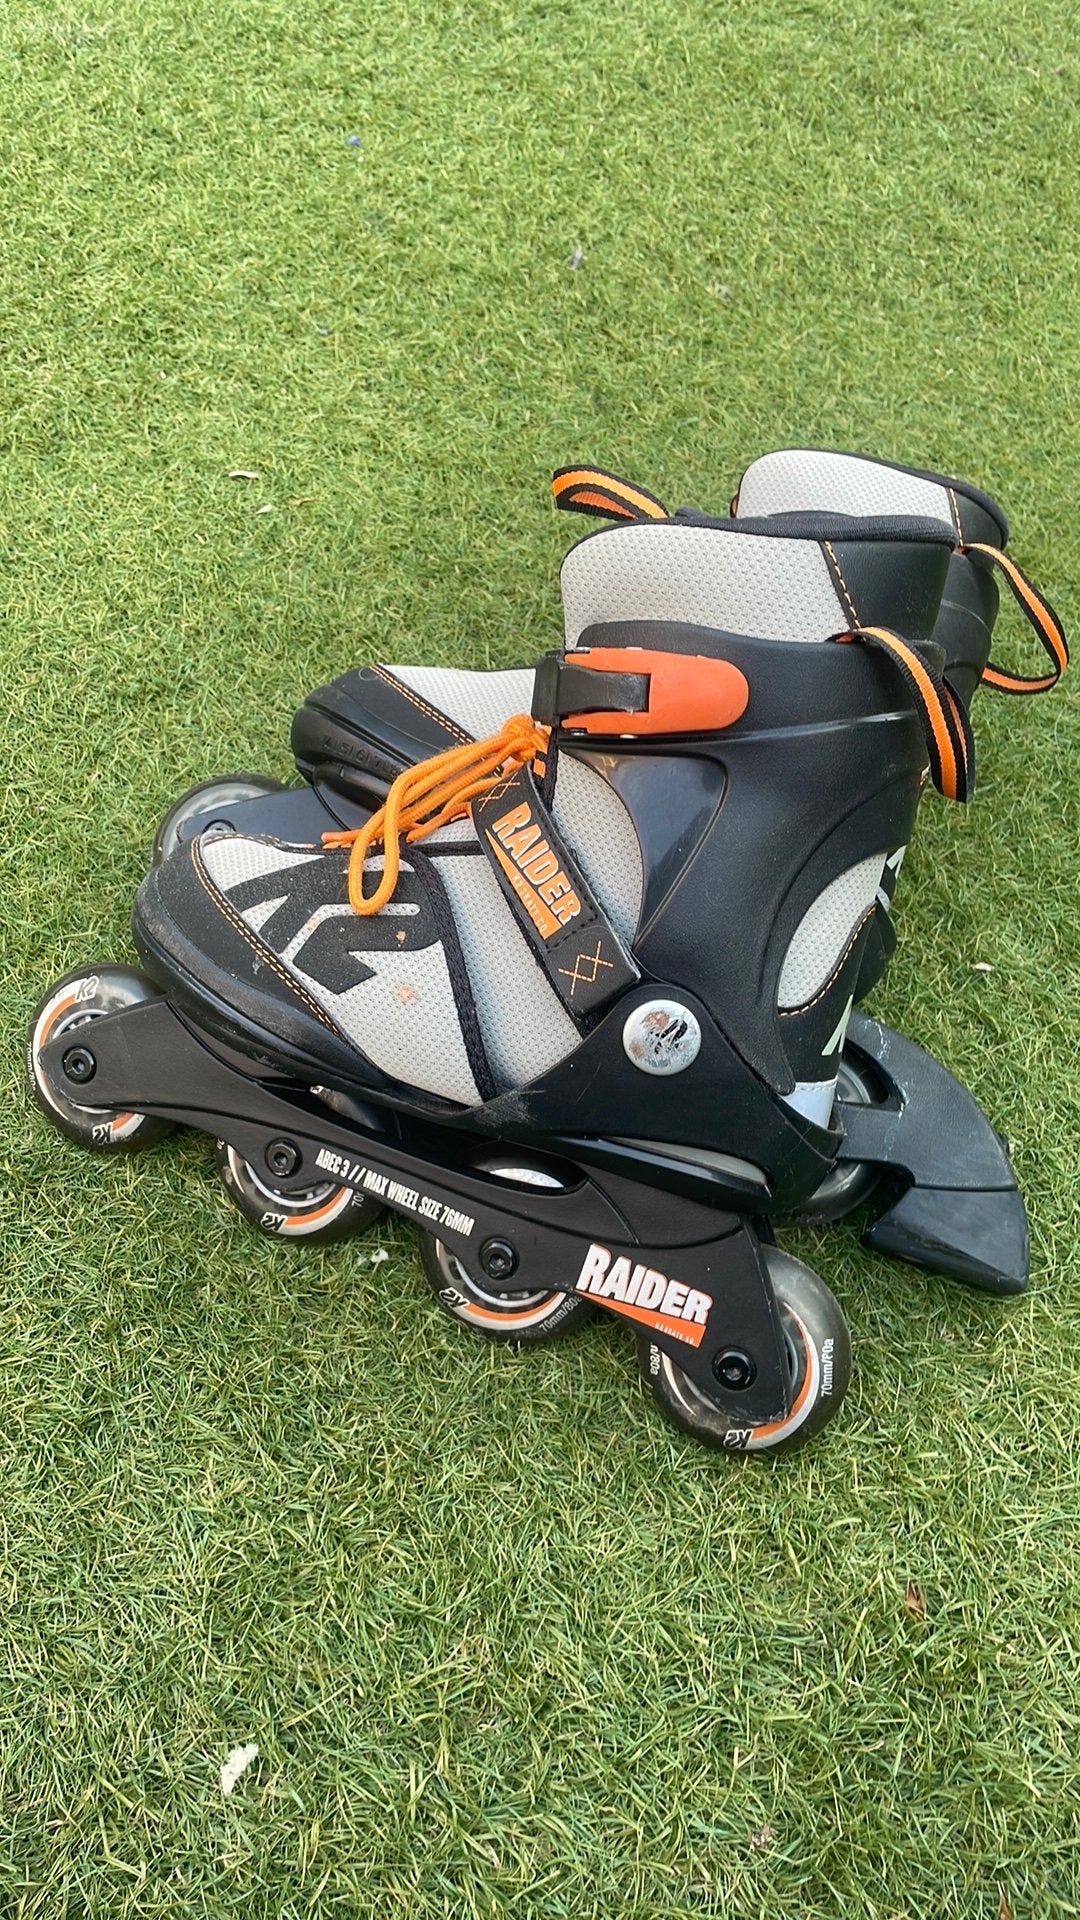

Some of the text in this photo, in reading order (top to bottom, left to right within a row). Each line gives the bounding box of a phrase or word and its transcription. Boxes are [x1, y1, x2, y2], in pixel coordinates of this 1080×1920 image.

[491, 801, 581, 926] RAIDER
[520, 888, 540, 916] SKATE
[222, 852, 443, 995] K2
[75, 975, 99, 1002] K2
[92, 1121, 113, 1145] K2
[315, 1149, 342, 1174] ABEC
[340, 1160, 350, 1177] 3
[348, 1165, 366, 1184] //
[363, 1170, 389, 1196] MAX
[387, 1181, 419, 1210] WHEEL
[418, 1196, 443, 1221] SIZE
[439, 1205, 475, 1237] 76MM
[260, 1212, 288, 1231] K2
[576, 1243, 713, 1324] RAIDER
[439, 1287, 470, 1309] K2
[722, 1429, 753, 1449] K2
